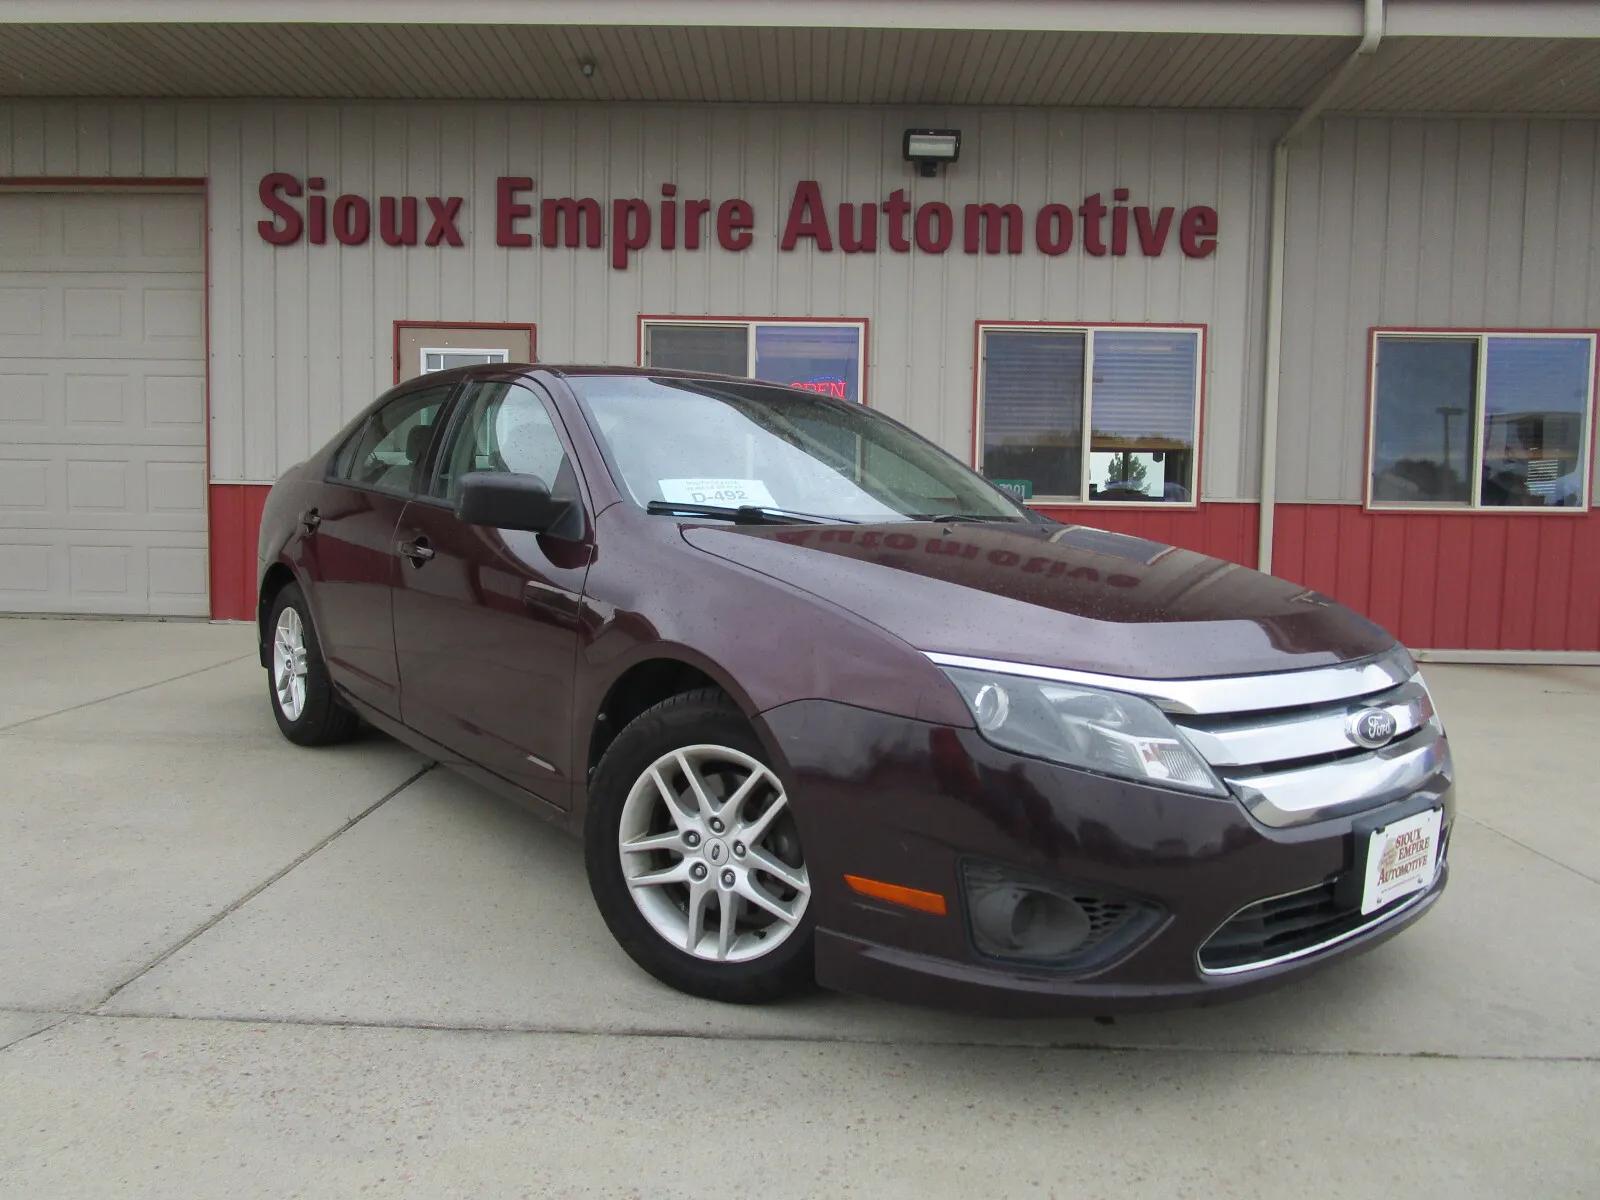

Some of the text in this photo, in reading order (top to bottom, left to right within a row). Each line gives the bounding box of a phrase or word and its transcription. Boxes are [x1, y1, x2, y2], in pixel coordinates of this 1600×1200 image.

[257, 172, 1219, 270] Sioux Empire Automotive
[691, 489, 749, 503] D-492
[1367, 715, 1392, 738] Ford
[1395, 827, 1423, 849] SIOUX
[1398, 836, 1431, 861] EMPIRE
[1377, 854, 1429, 887] AUTOMOTIVE
